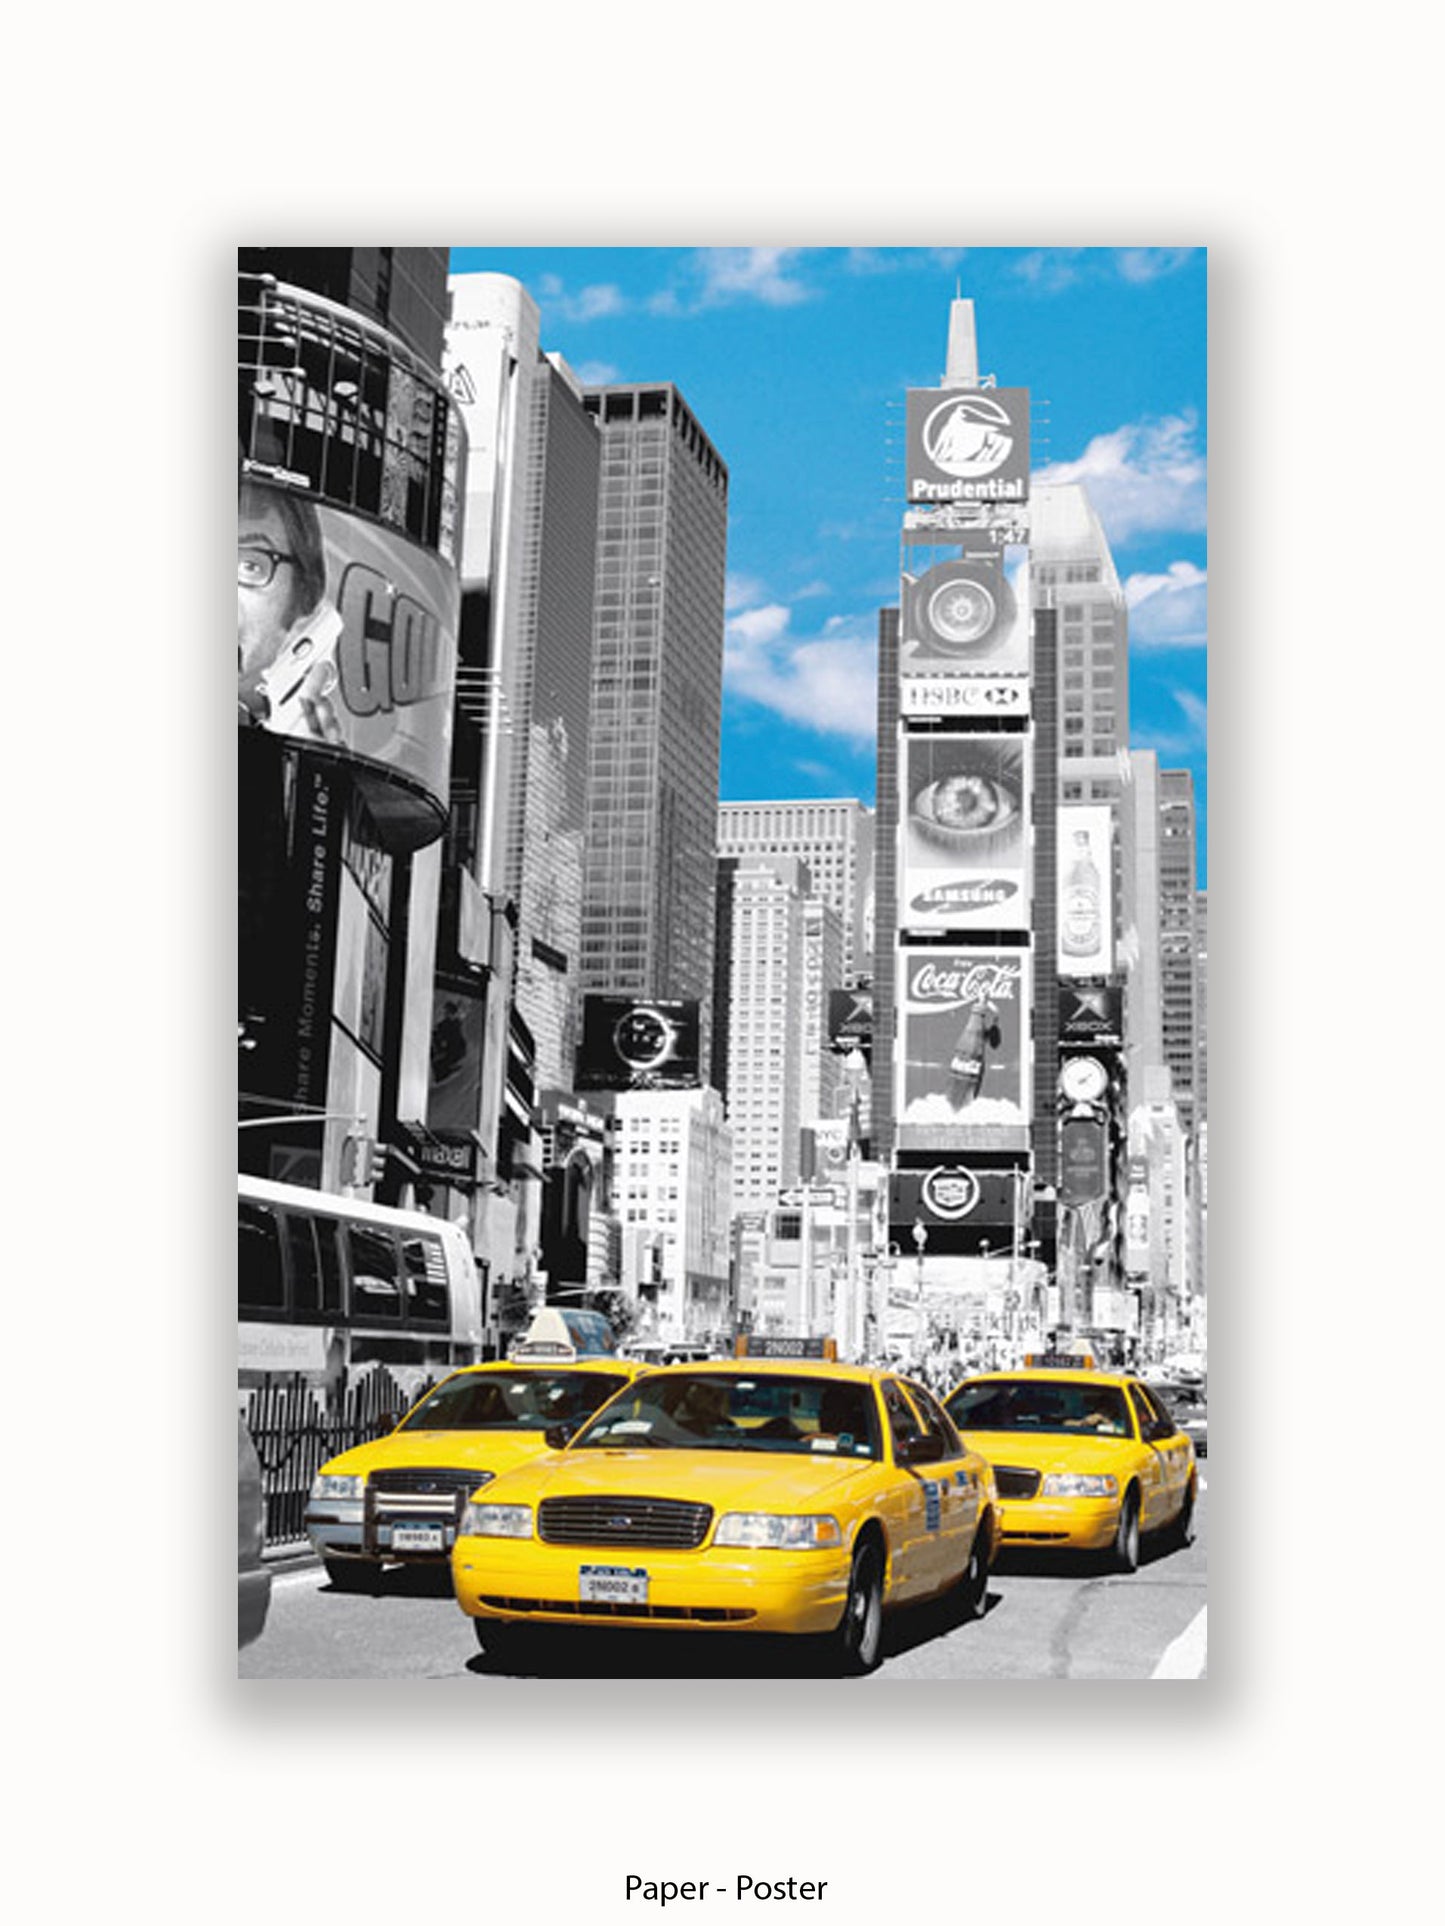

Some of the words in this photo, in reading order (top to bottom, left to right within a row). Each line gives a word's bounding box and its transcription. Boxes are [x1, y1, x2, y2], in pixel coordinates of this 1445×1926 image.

[912, 479, 1022, 498] Prudential
[910, 687, 981, 705] HSBC
[306, 845, 327, 913] Share
[922, 888, 1006, 902] SAMSUNG
